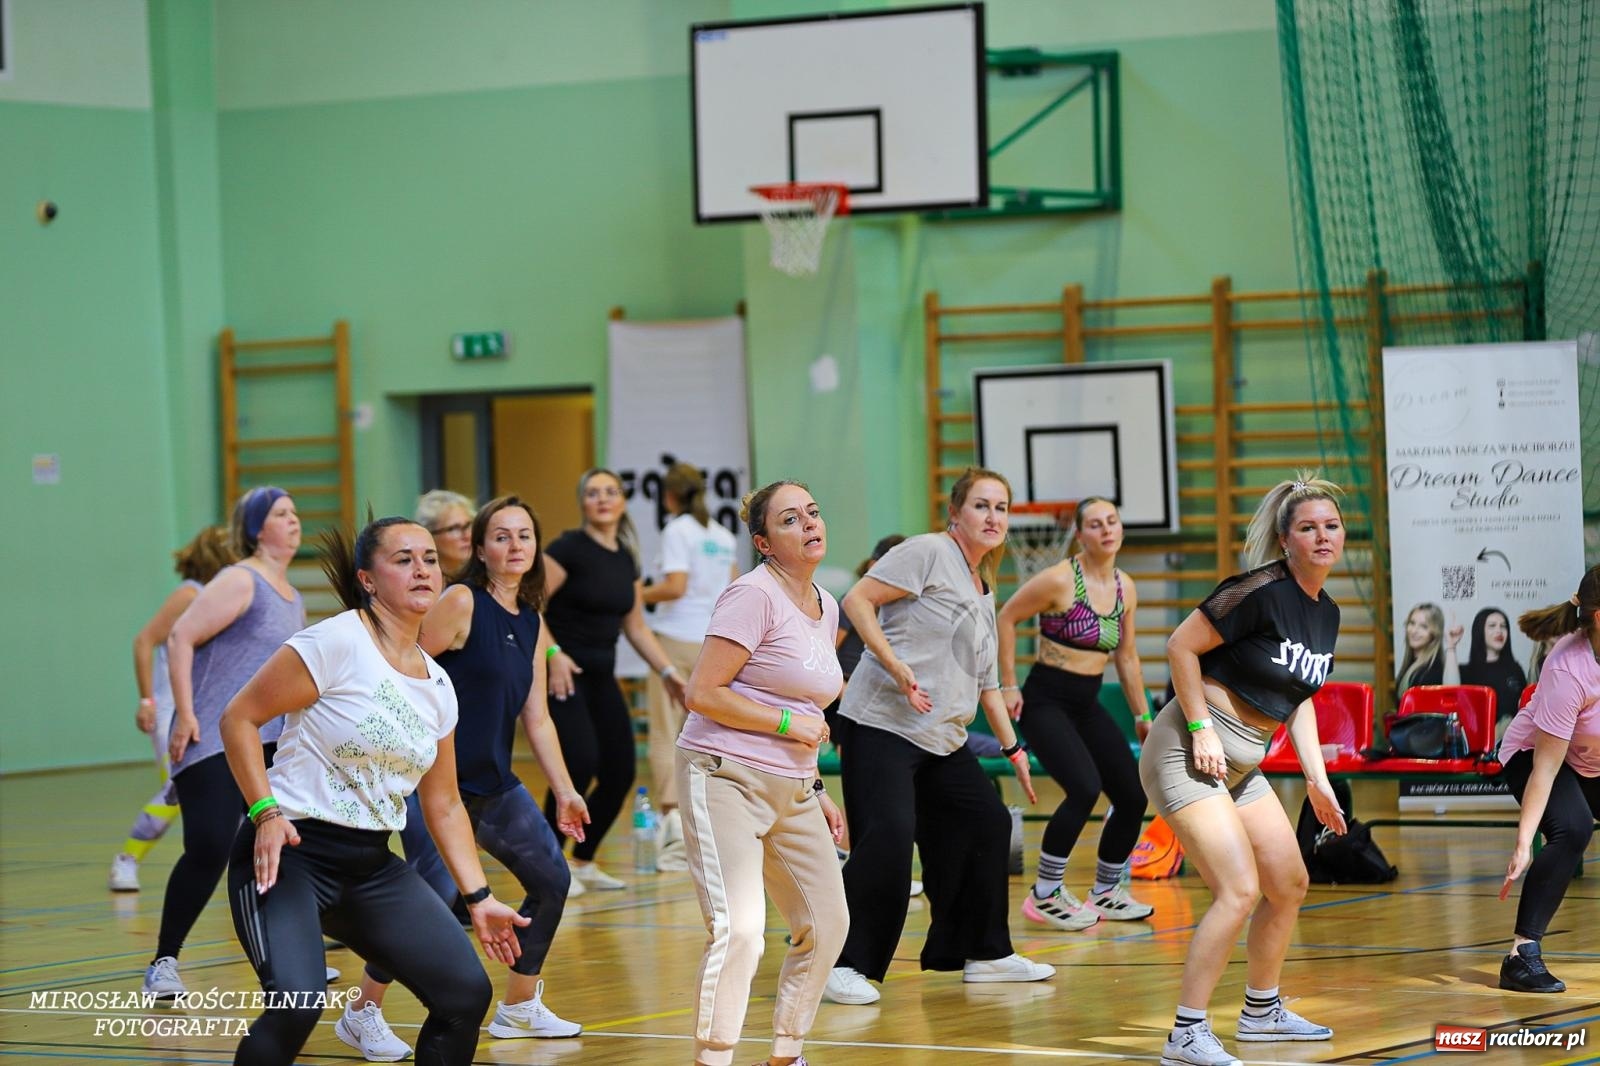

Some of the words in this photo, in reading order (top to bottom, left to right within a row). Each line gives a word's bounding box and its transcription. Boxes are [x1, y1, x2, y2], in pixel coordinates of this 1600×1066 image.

[1390, 463, 1483, 491] Dream
[1491, 459, 1579, 485] Dance
[1450, 484, 1522, 511] Studio
[1271, 638, 1333, 687] SPORT
